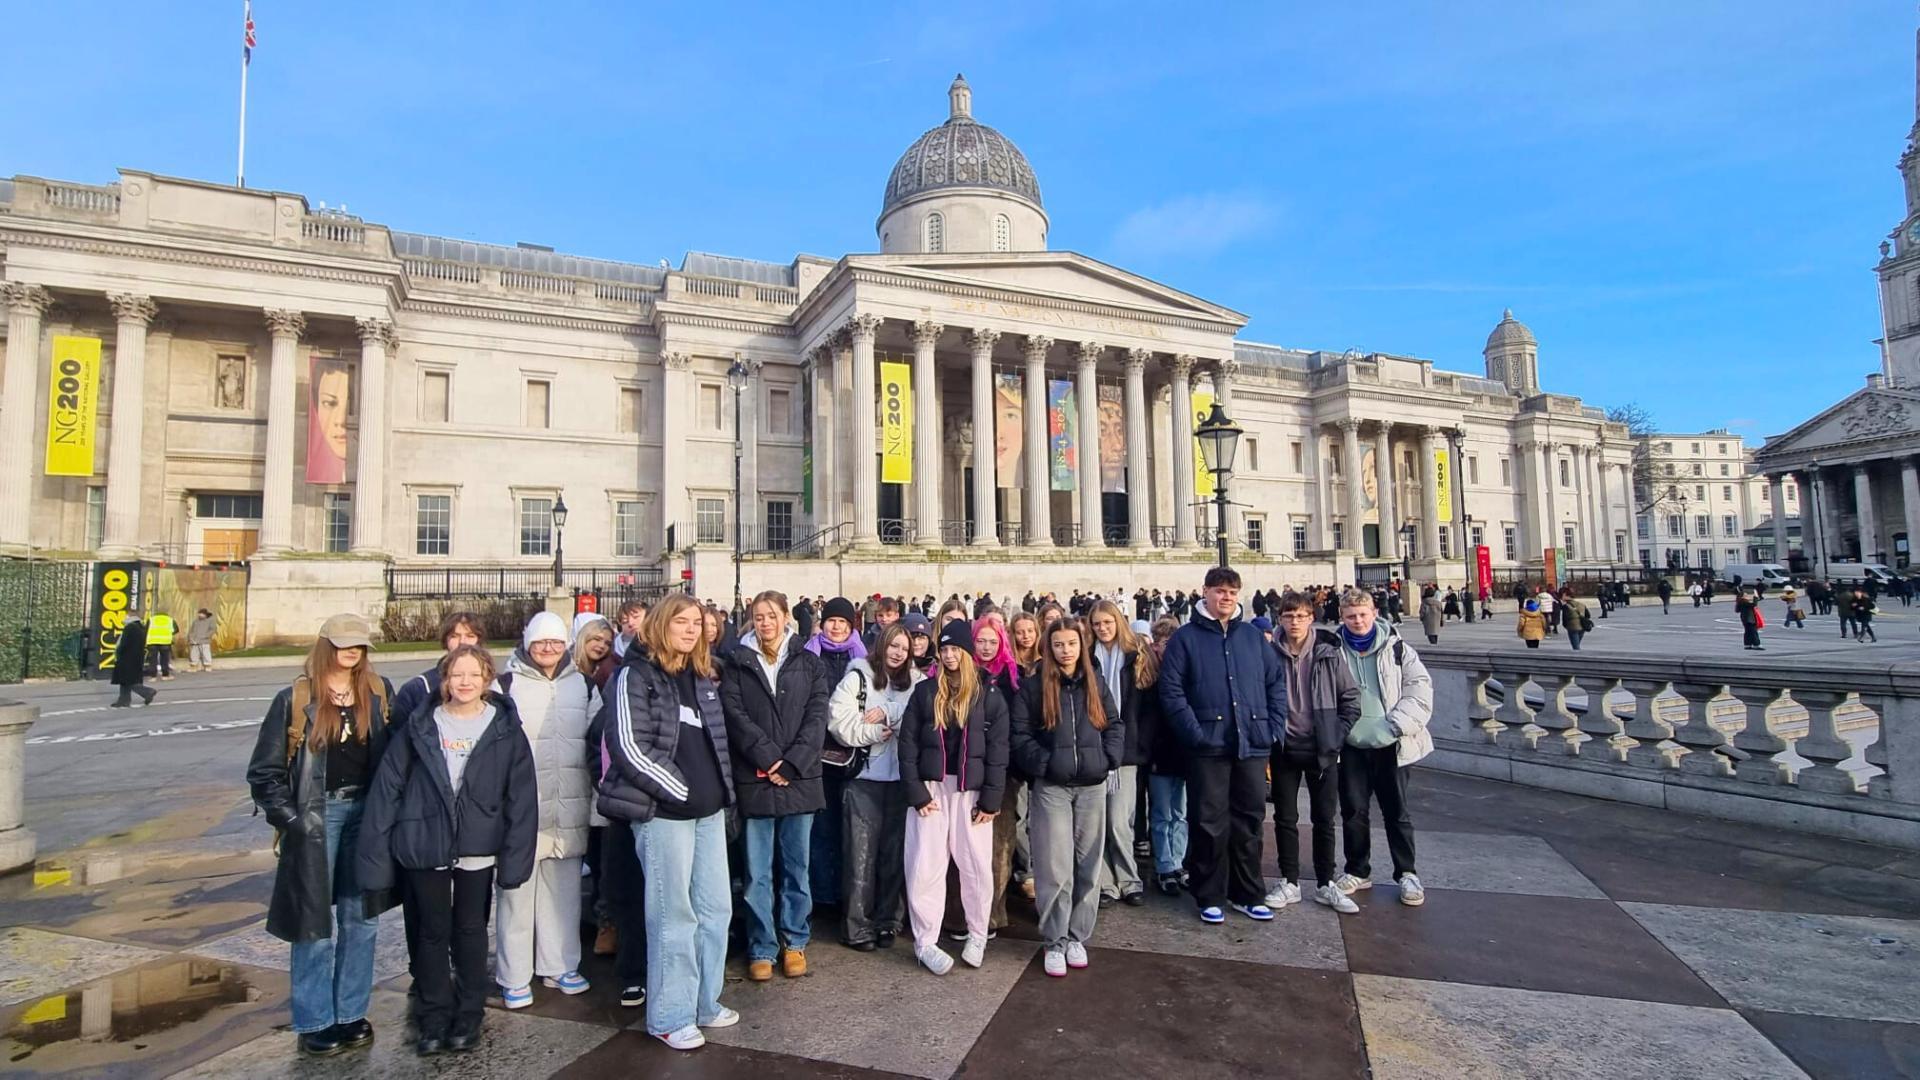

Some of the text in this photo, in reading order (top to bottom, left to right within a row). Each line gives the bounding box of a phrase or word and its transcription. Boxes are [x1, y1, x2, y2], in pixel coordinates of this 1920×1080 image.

[55, 359, 81, 445] NG200
[887, 382, 902, 456] NG200
[99, 569, 129, 669] NG200
